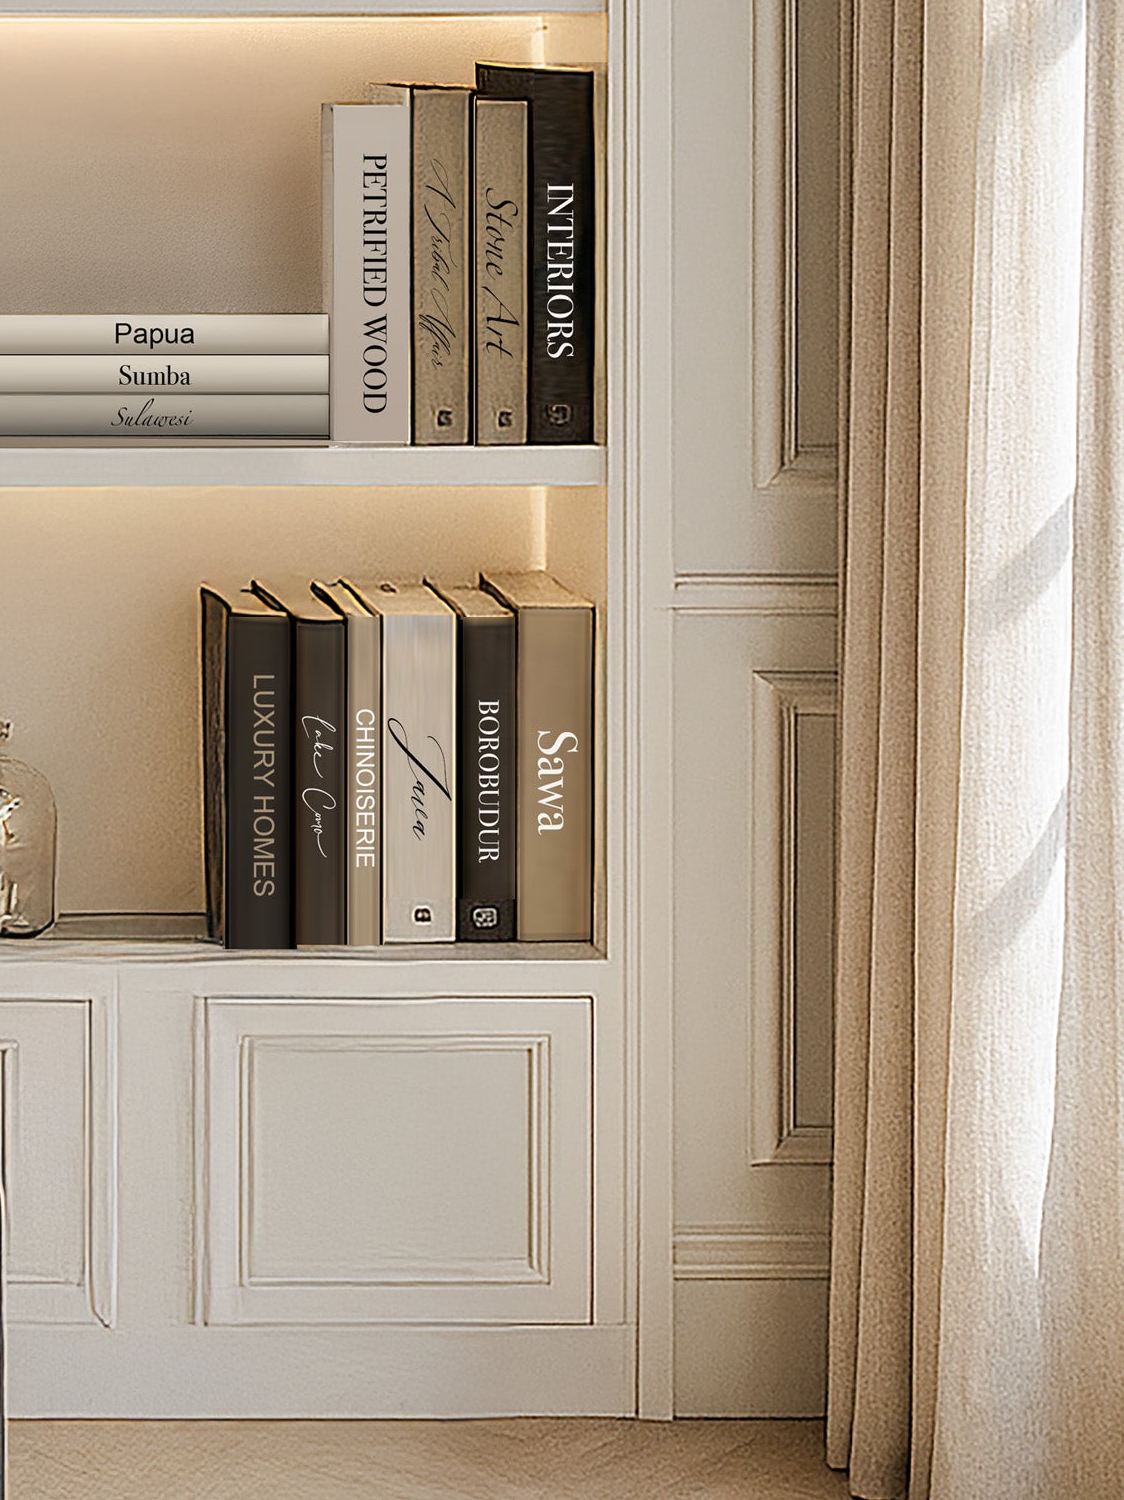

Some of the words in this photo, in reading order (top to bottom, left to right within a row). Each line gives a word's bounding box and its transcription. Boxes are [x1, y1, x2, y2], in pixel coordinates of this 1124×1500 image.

[424, 157, 457, 211] A
[362, 153, 388, 308] PETRIFIED
[423, 203, 458, 292] Tribal
[485, 186, 519, 277] Stone
[546, 182, 575, 359] INTERIORS
[114, 322, 195, 350] Papua
[362, 313, 388, 414] WOOD
[419, 288, 457, 371] Affair
[481, 285, 521, 359] Art
[110, 397, 194, 428] Sulawesi
[118, 364, 192, 387] Sumba
[252, 673, 276, 788] LUXURY
[301, 714, 337, 779] Lake
[301, 787, 337, 859] Como
[355, 707, 376, 869] CHINOISERIE
[387, 716, 452, 842] Java
[477, 699, 501, 863] BOROBUDUR
[536, 729, 580, 836] Sawa
[252, 795, 276, 898] HOMES
